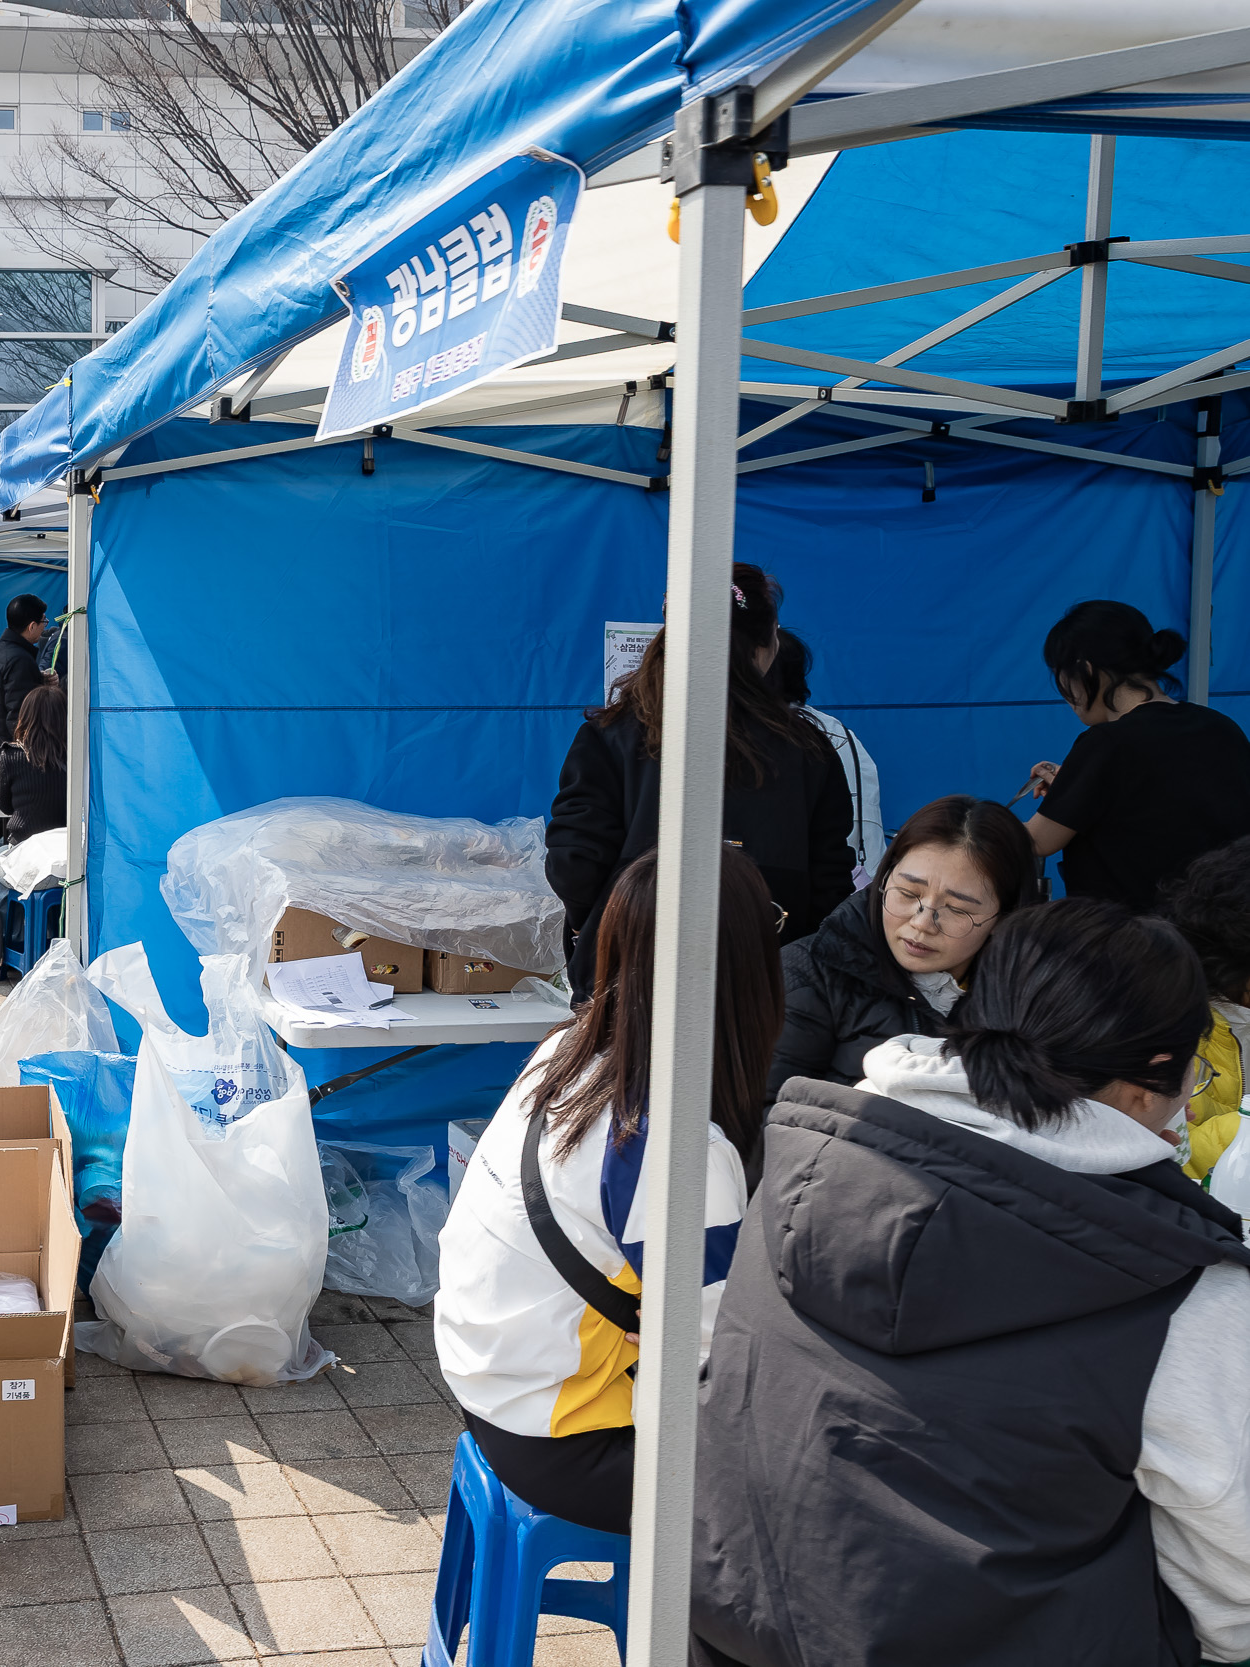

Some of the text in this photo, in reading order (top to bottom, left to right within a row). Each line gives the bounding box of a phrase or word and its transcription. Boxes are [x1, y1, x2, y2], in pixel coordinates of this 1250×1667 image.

[385, 202, 513, 347] 광남클럽
[10, 1381, 26, 1389] 참가
[6, 1391, 31, 1399] 기념품
